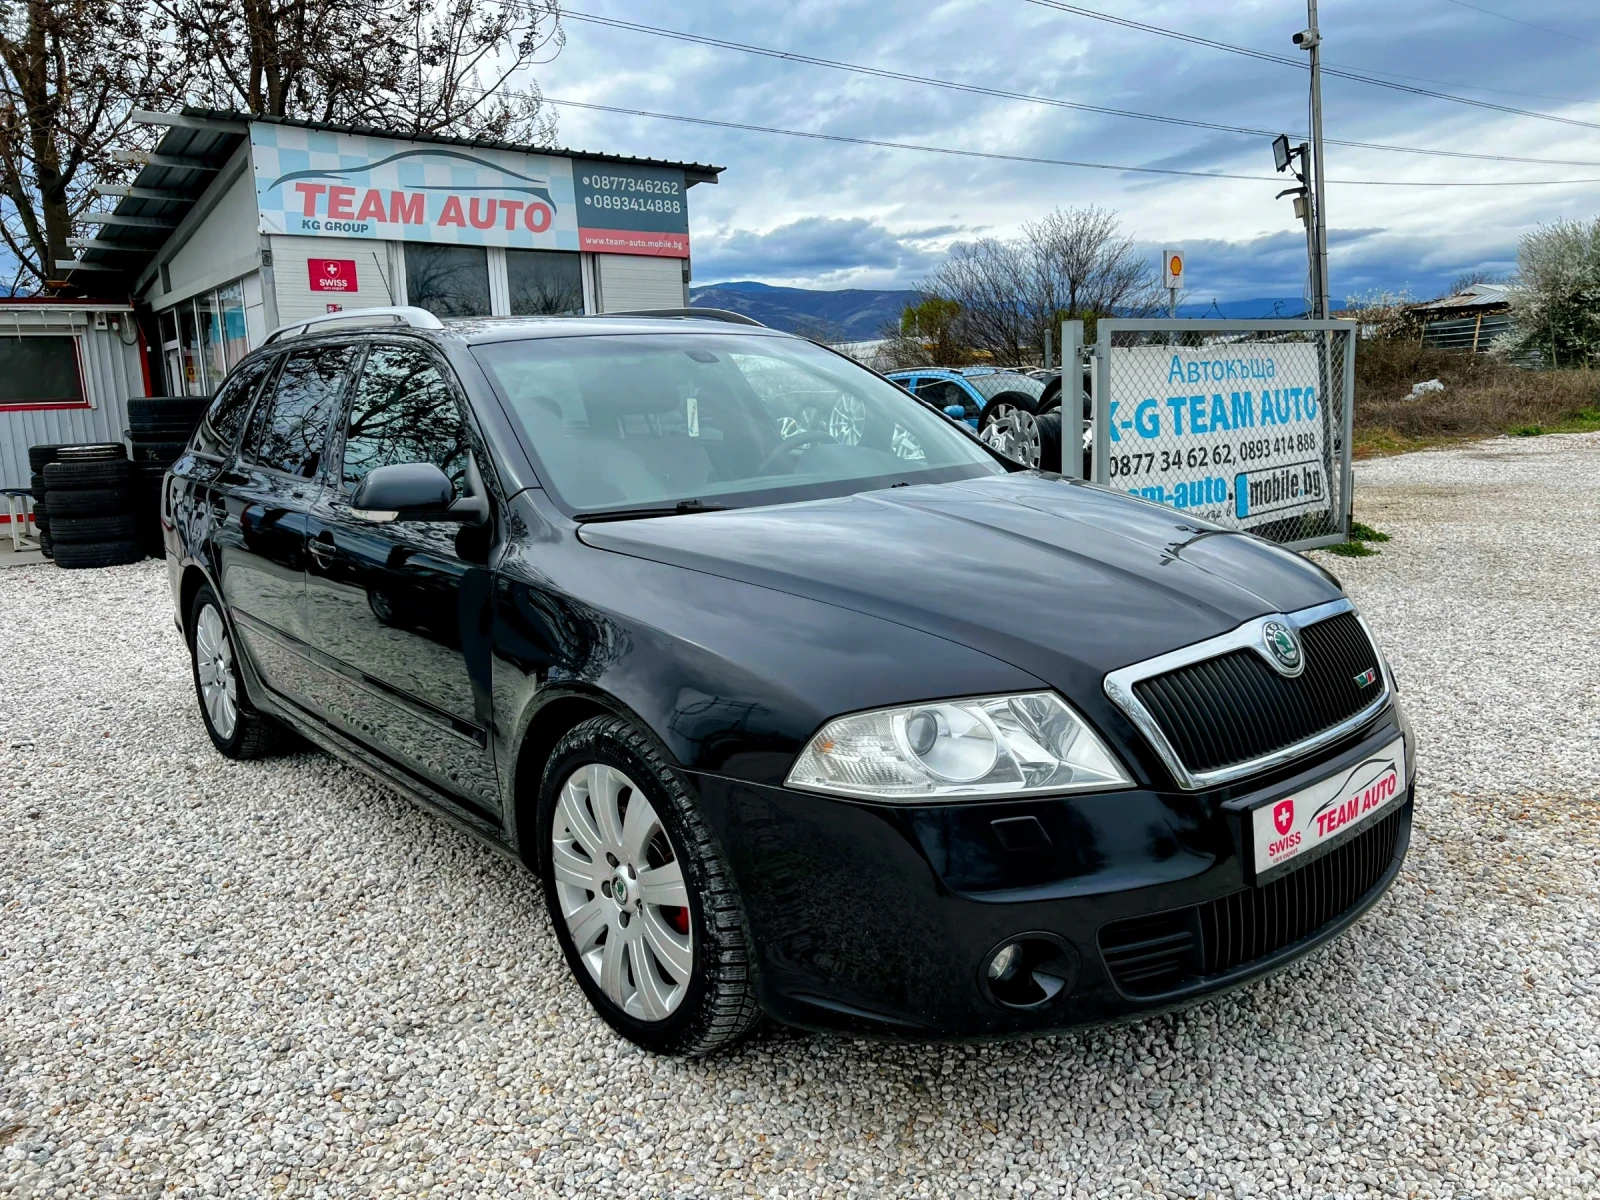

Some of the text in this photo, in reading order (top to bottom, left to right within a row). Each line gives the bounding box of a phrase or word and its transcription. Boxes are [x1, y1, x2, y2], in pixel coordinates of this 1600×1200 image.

[591, 175, 679, 195] 0877346262
[295, 182, 551, 234] TEAM AUTO
[593, 195, 681, 213] 0893414888
[301, 219, 369, 234] KG GROUP
[584, 236, 683, 251] www.team-auto.mobile.bg
[319, 278, 348, 287] SWISS
[1167, 354, 1276, 384] Автокъща
[1166, 391, 1255, 436] TEAM
[1261, 386, 1318, 427] AUTO
[1109, 452, 1155, 477] 0877
[1160, 449, 1183, 472] 34
[1186, 446, 1209, 467] 62
[1239, 438, 1272, 462] 0893
[1273, 434, 1295, 453] 414
[1296, 432, 1316, 451] 888
[1316, 773, 1397, 838] TEAM AUTO
[1268, 831, 1302, 857] SWISS
[1272, 847, 1298, 864] cars export
